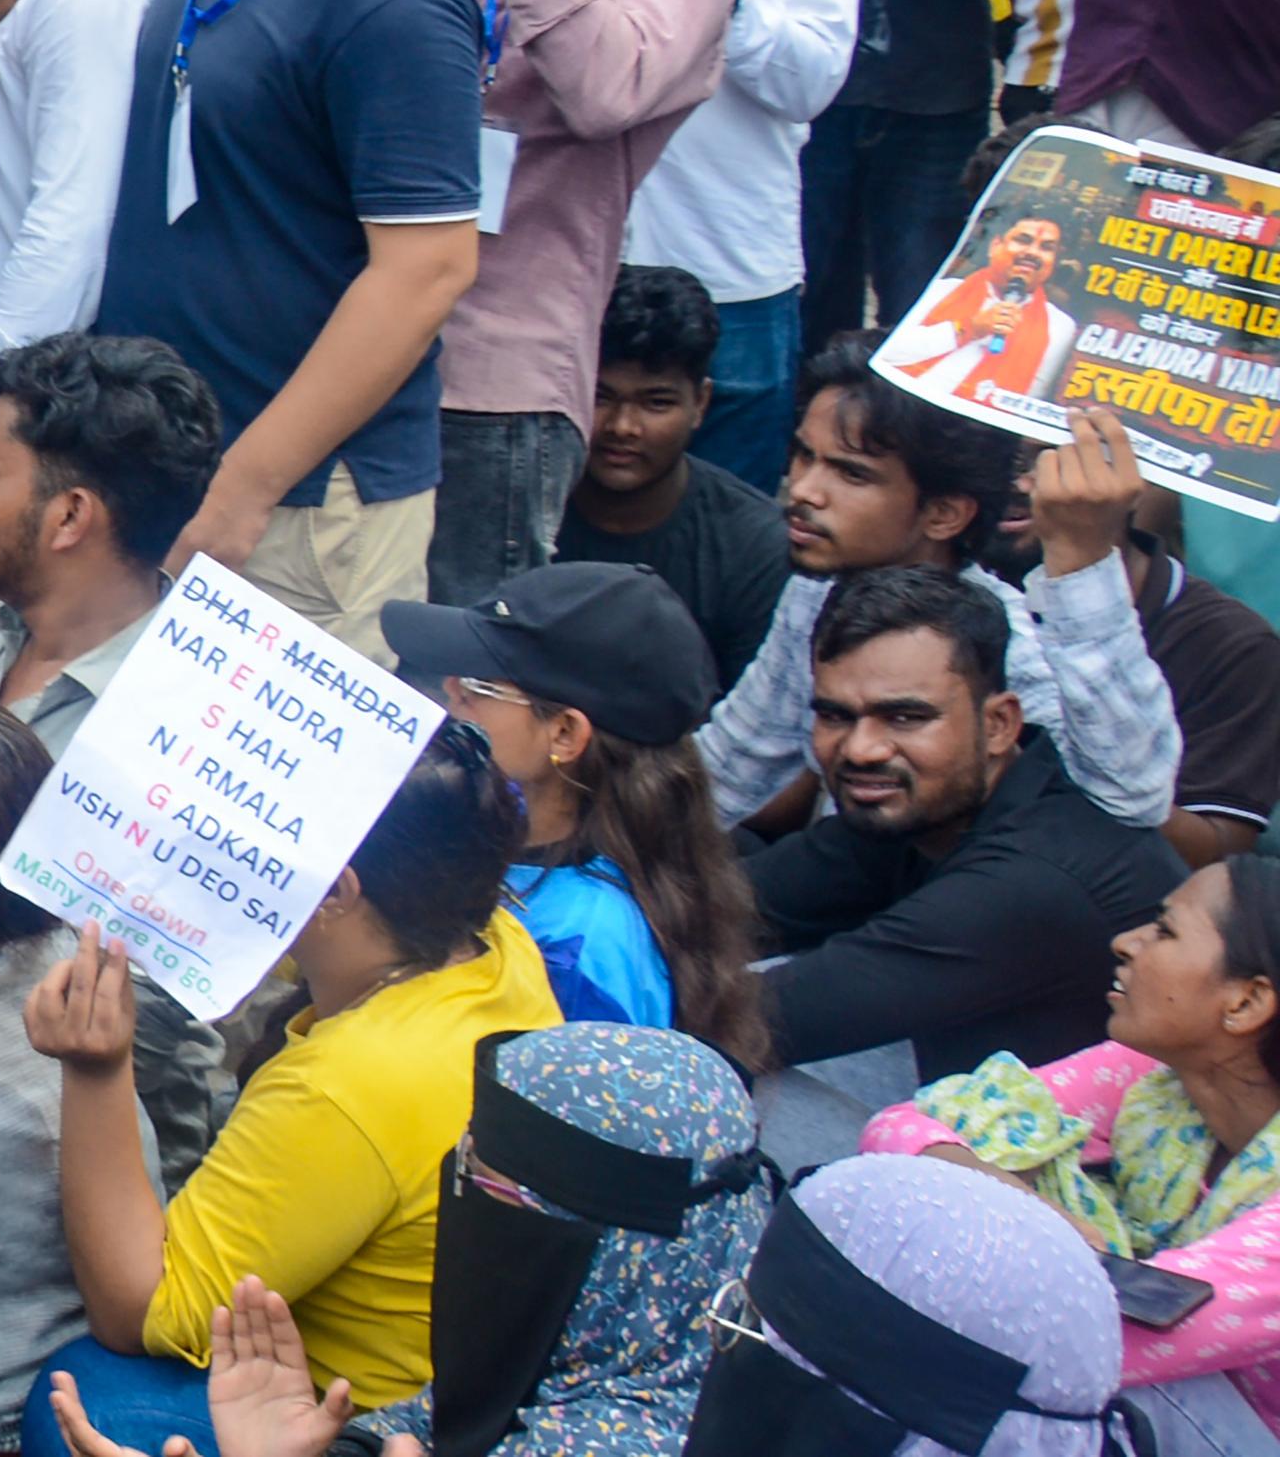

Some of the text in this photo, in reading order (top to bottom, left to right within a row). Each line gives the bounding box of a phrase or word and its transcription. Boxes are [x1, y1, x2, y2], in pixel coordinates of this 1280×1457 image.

[1098, 214, 1172, 257] NEET
[1167, 230, 1254, 278] PAPER
[1139, 313, 1170, 335] को
[1164, 284, 1249, 330] PAPER
[1075, 323, 1219, 383] GAJENDRA
[1063, 360, 1230, 435] इस्तीफा
[13, 851, 83, 908] Many
[86, 901, 151, 947] more
[153, 943, 180, 969] to
[73, 850, 209, 946] One down
[178, 853, 240, 904] DEO
[241, 897, 293, 940] SAI
